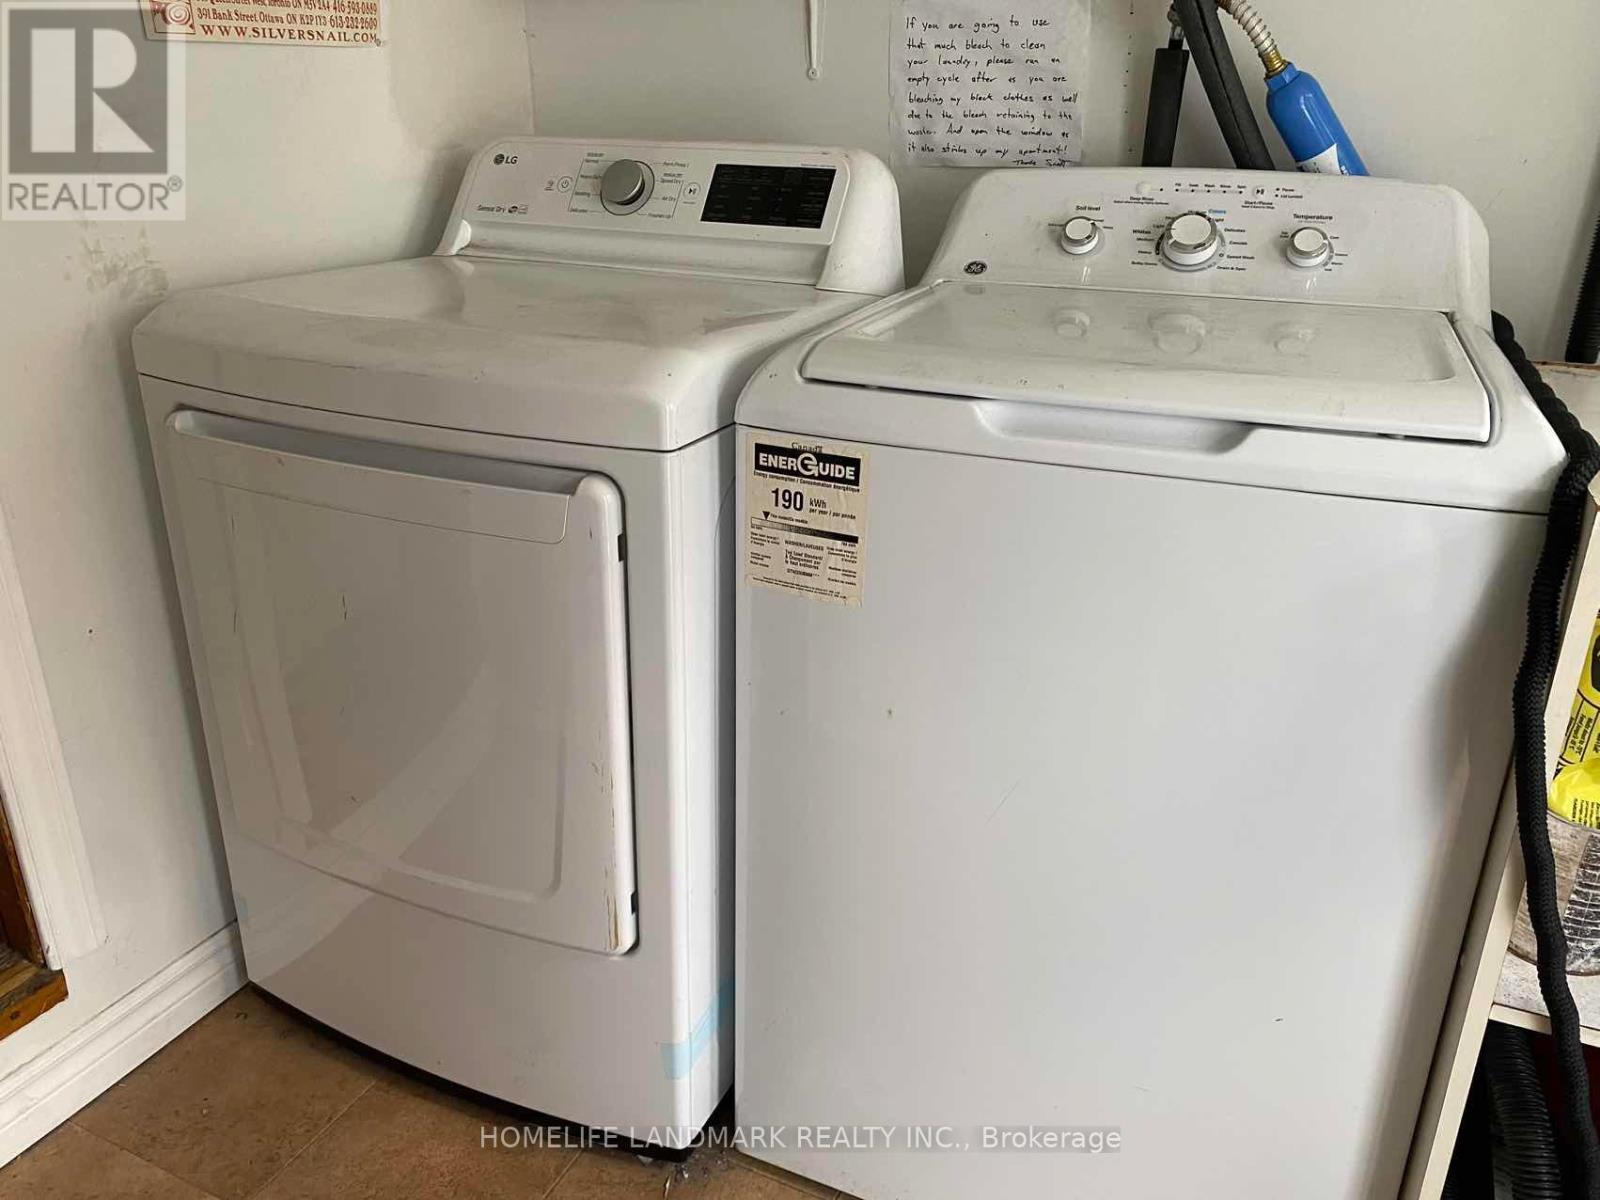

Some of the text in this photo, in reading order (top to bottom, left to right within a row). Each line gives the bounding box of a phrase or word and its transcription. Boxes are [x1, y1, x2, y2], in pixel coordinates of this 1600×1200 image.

[212, 9, 233, 21] Bank
[234, 10, 258, 22] Street
[259, 11, 284, 24] Ottawa
[286, 13, 297, 25] ON
[906, 16, 917, 29] If
[922, 22, 939, 32] you
[973, 17, 999, 34] going
[1010, 14, 1020, 27] to
[1032, 19, 1051, 27] use
[201, 25, 377, 43] WWW.SILVERSNAIL.COM
[907, 37, 1046, 51] that much bleach to clean
[907, 59, 928, 69] your
[986, 55, 1014, 67] please
[907, 71, 930, 87] empty
[937, 73, 960, 87] cycle
[971, 71, 997, 83] after
[1028, 76, 1044, 86] you
[908, 91, 944, 105] bleaching
[950, 96, 961, 106] my
[970, 92, 993, 101] black
[1003, 92, 1034, 102] clothes
[1062, 92, 1078, 104] well
[908, 109, 921, 119] due
[925, 108, 933, 119] to
[941, 109, 954, 119] the
[962, 109, 987, 118] bleach
[1043, 110, 1051, 119] to
[1058, 111, 1073, 120] the
[945, 122, 963, 134] And
[996, 125, 1011, 135] the
[1021, 126, 1052, 136] window
[908, 141, 916, 152] it
[975, 148, 987, 157] up
[995, 148, 1008, 158] my
[1293, 213, 1333, 221] Temperature
[759, 452, 856, 480] ENERGUIDE
[771, 487, 804, 511] 190
[809, 497, 827, 509] kWh
